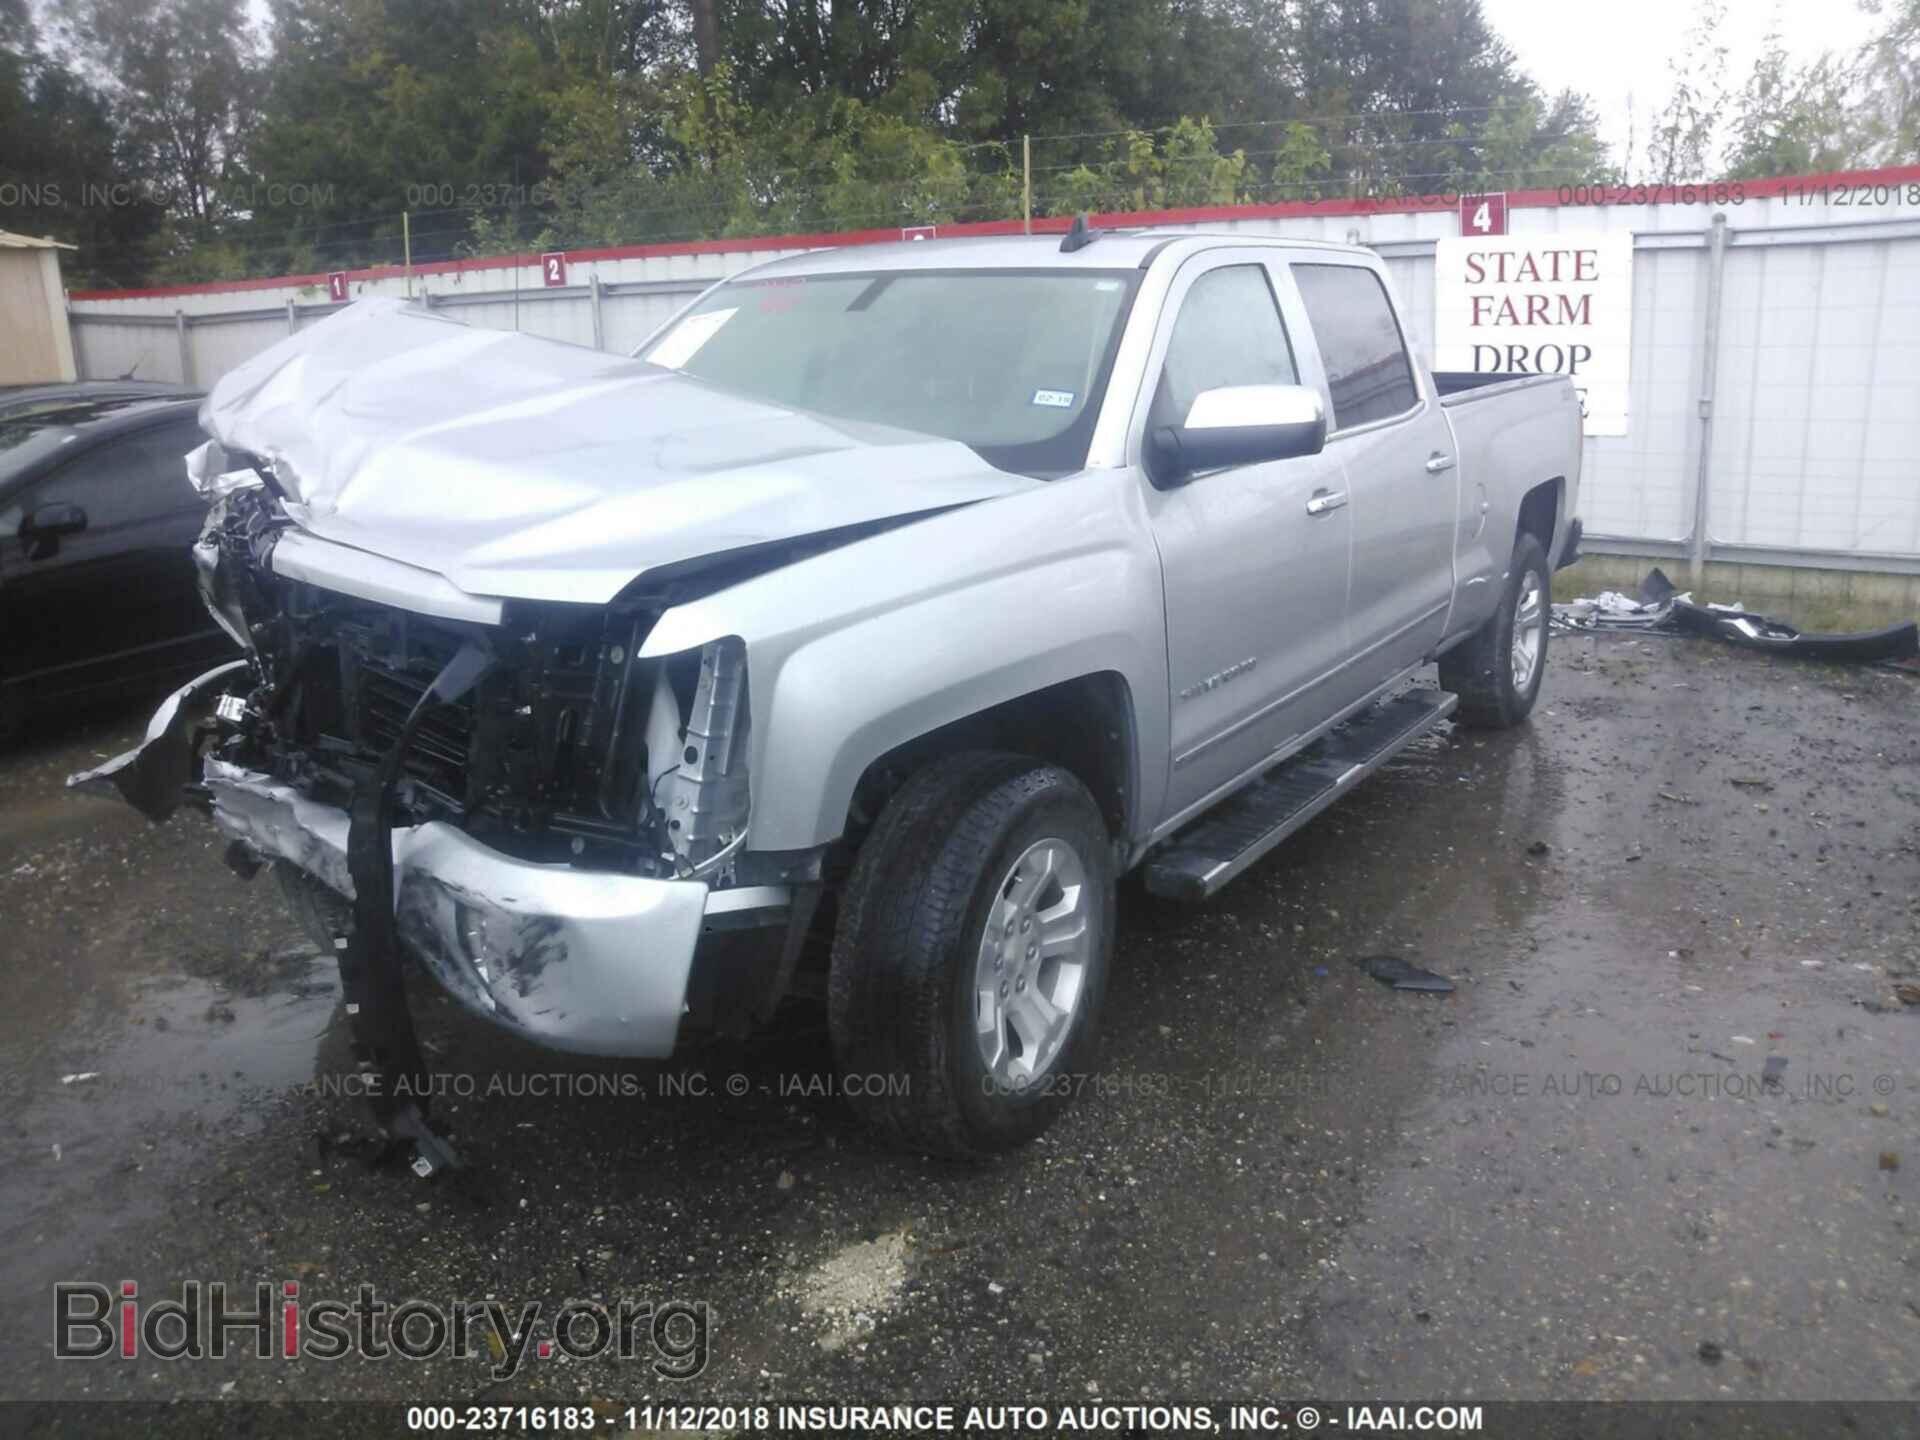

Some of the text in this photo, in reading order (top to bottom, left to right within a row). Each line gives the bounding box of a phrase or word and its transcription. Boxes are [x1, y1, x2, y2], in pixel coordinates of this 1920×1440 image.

[1472, 202, 1492, 232] 4
[549, 259, 560, 281] 2
[1464, 249, 1600, 284] STATE
[333, 277, 342, 297] 1
[1470, 294, 1592, 326] FARM
[1472, 344, 1592, 375] DROP
